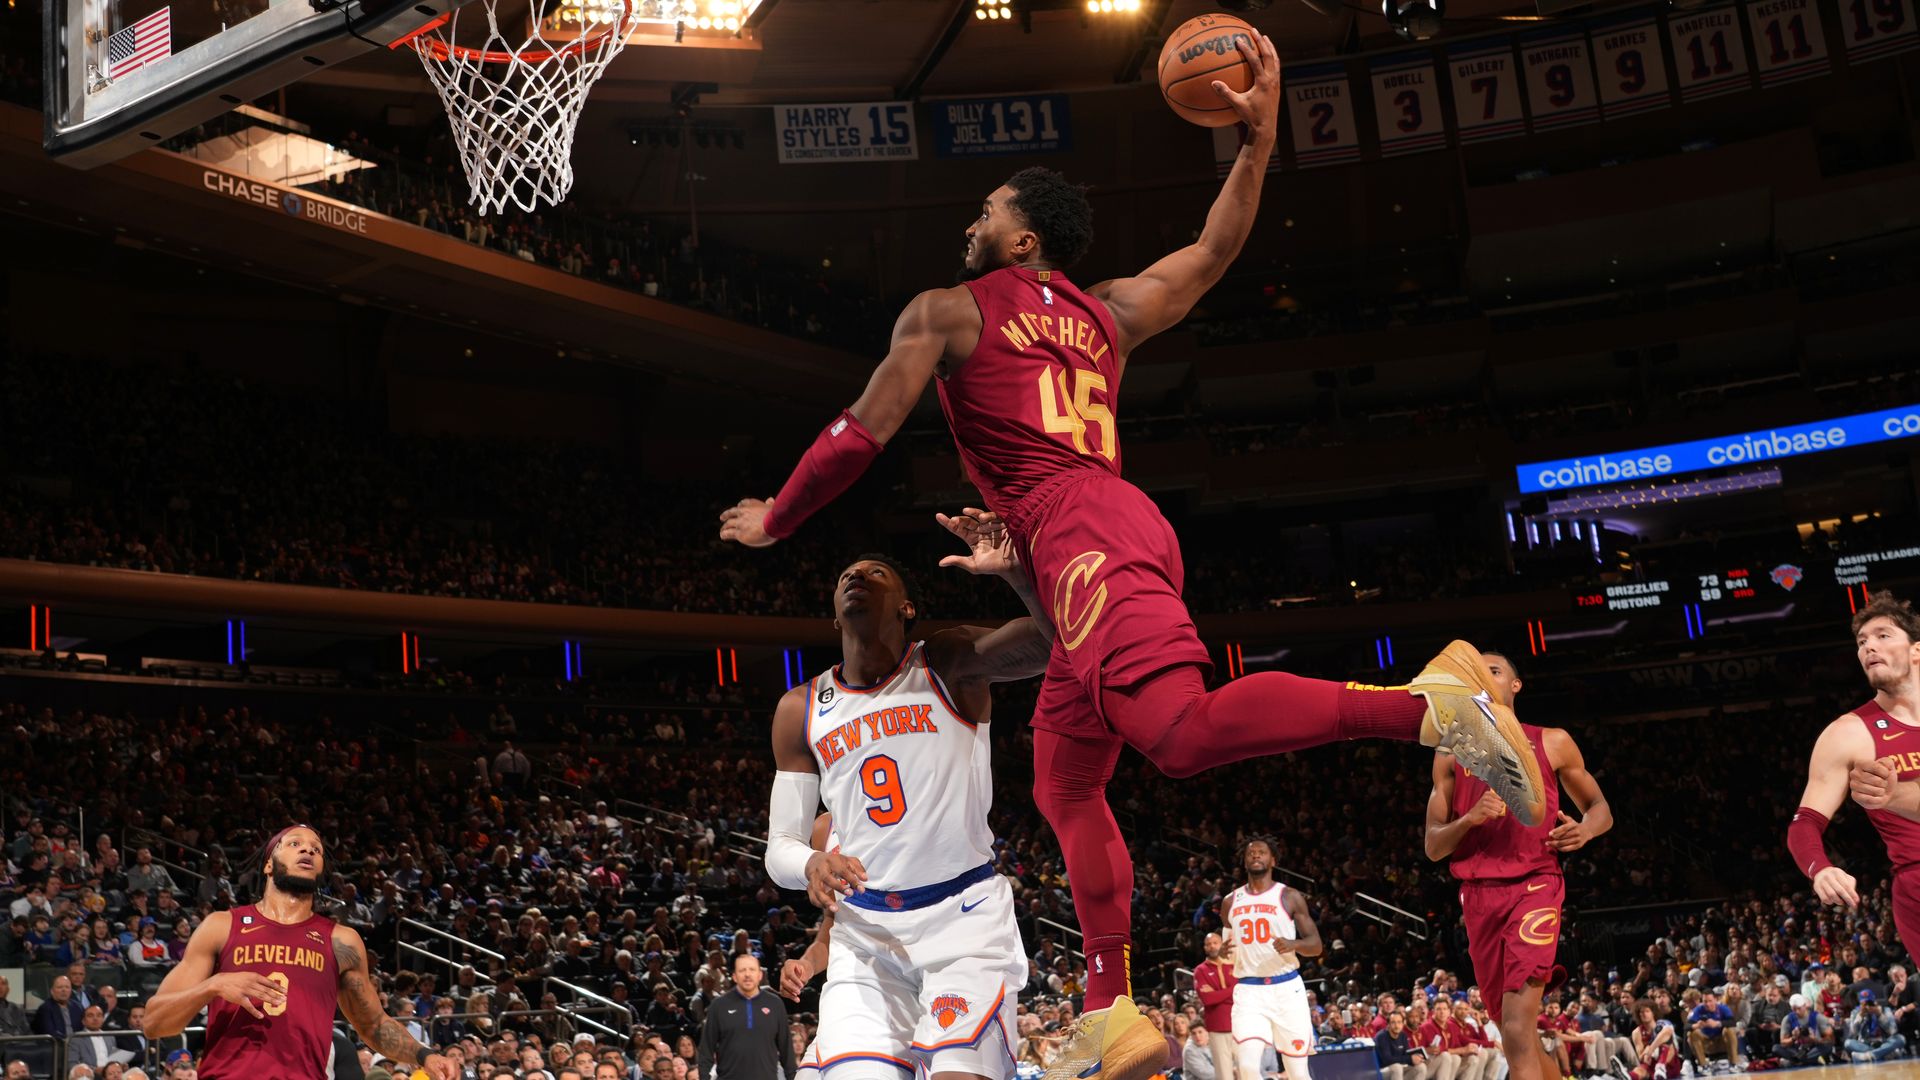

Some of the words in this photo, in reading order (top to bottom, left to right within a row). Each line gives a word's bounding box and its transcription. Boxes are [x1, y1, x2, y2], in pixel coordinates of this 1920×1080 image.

[1757, 0, 1807, 18] MESSIER
[1849, 0, 1905, 41] 19
[1604, 32, 1647, 50] GRAVES
[1765, 14, 1812, 64] 11
[1527, 47, 1581, 66] BATHGATE
[1687, 30, 1733, 80] 11
[1458, 60, 1505, 77] GILBERT
[1616, 50, 1646, 94] 9
[1383, 73, 1425, 89] HOWELL
[1545, 64, 1575, 107] 9
[1296, 86, 1340, 102] LEETCH
[1470, 76, 1498, 120] 7
[786, 107, 851, 127] HARRY
[947, 103, 985, 124] BILLY
[991, 99, 1060, 143] 131
[1308, 102, 1338, 145] 2
[1393, 90, 1422, 133] 3
[868, 105, 910, 145] 15
[953, 124, 987, 144] JOEL
[783, 127, 860, 148] STYLES
[203, 170, 279, 208] CHASE
[306, 201, 367, 233] BRIDGE
[1038, 364, 1116, 462] 45
[1707, 427, 1847, 465] coinbase
[1538, 454, 1673, 489] coinbase
[1834, 565, 1868, 576] Randle
[1837, 552, 1880, 566] ASSISTS
[1606, 580, 1670, 597] GRIZZLIES
[1698, 574, 1720, 588] 73
[1836, 574, 1869, 586] Toppin
[1576, 594, 1604, 607] 7:30
[1608, 595, 1661, 611] PISTONS
[816, 717, 861, 770] NEW
[863, 704, 938, 740] YORK
[859, 753, 907, 828] 9
[1232, 905, 1252, 918] NEW
[1253, 903, 1278, 916] YORK
[1239, 918, 1271, 945] 30
[233, 944, 325, 973] CLEVELAND
